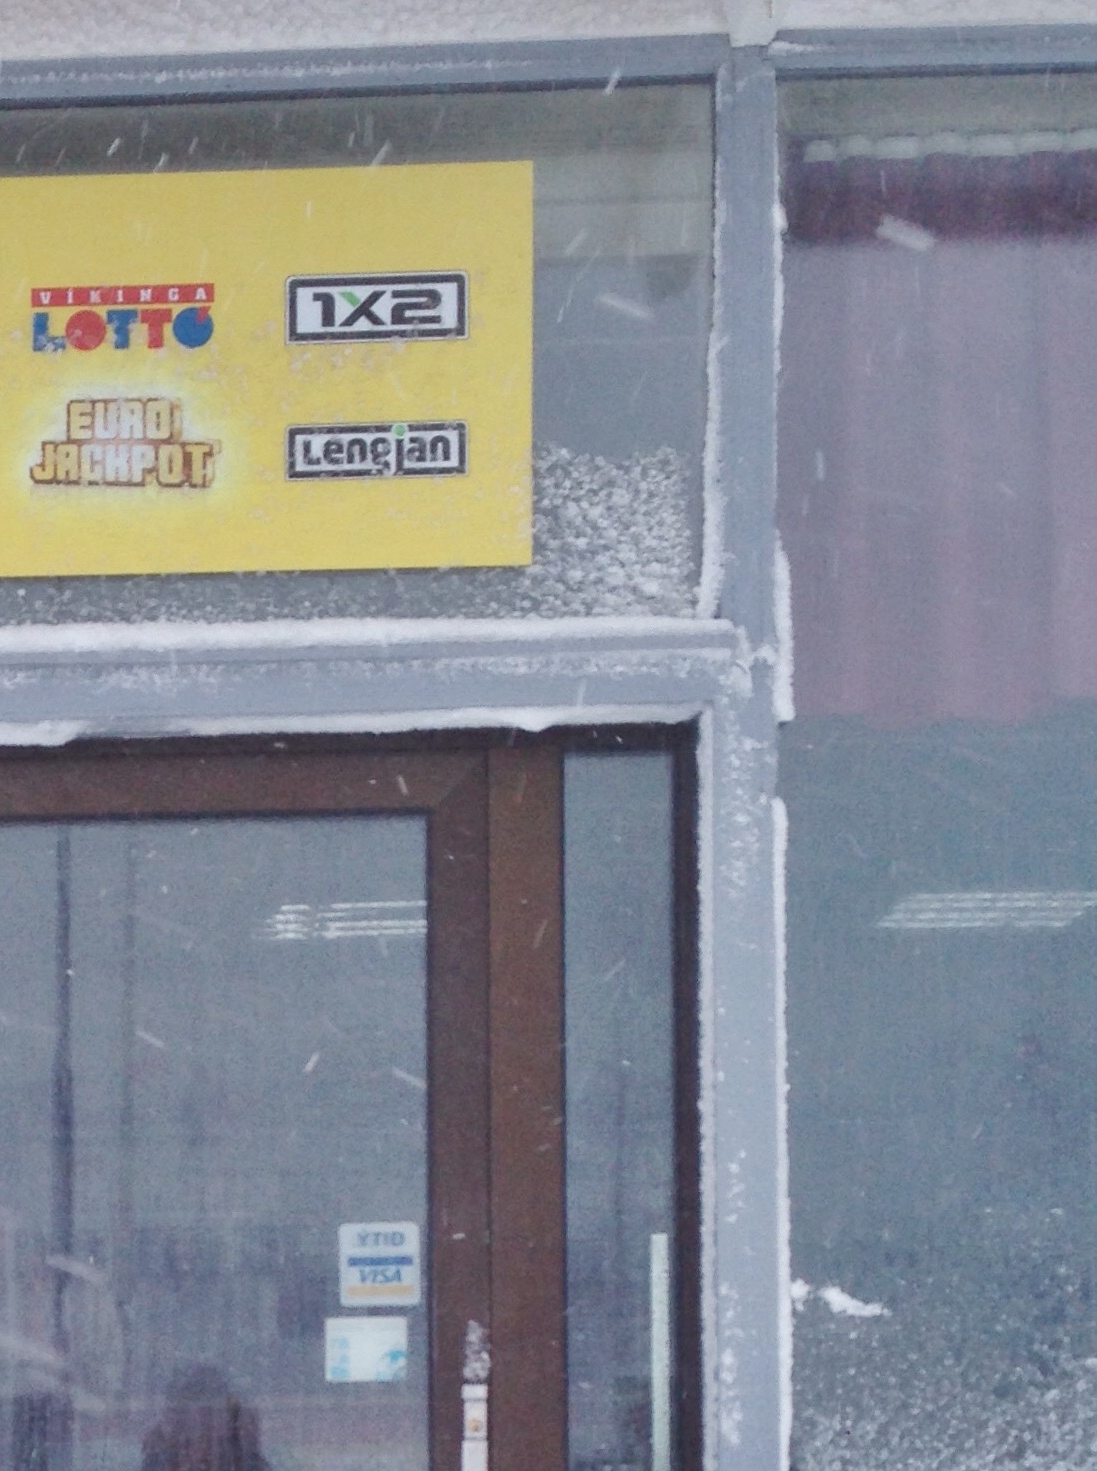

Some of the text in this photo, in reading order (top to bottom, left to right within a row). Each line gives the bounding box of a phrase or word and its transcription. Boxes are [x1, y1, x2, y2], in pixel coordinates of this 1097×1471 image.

[39, 287, 207, 305] VÍKINGA
[312, 288, 442, 327] 1X2
[32, 306, 214, 352] LOTTÓ
[66, 398, 183, 443] EURO
[29, 438, 222, 489] JACKPOT
[303, 422, 452, 476] Lengjan
[359, 1268, 402, 1284] VISA
